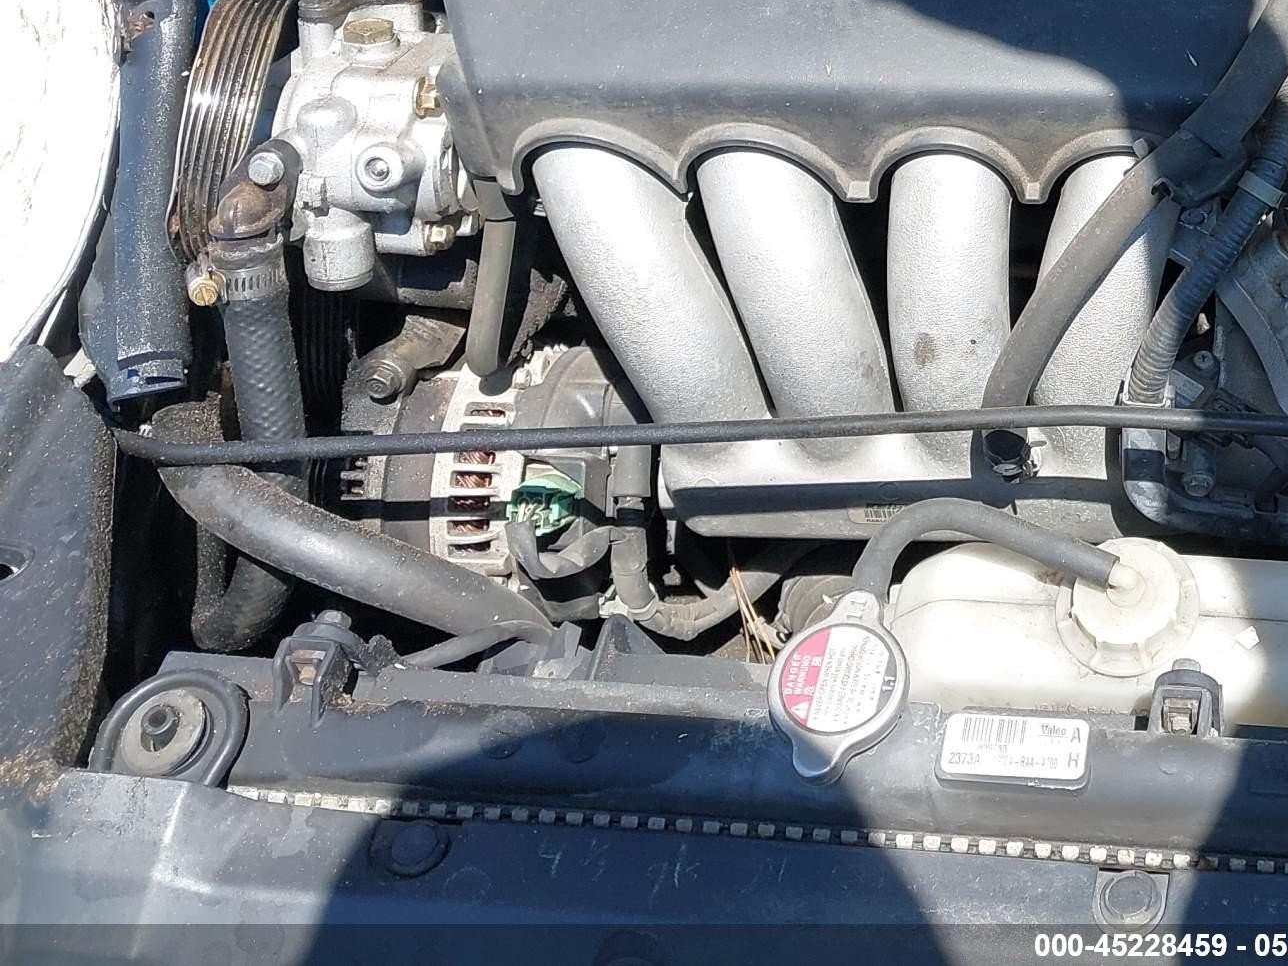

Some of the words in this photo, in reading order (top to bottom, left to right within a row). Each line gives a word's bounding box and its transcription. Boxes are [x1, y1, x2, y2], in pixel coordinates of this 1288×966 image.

[784, 654, 803, 695] DANGER
[794, 655, 812, 695] WARNUNG
[882, 676, 896, 692] 1.1
[1070, 727, 1081, 743] A
[1068, 752, 1079, 768] H
